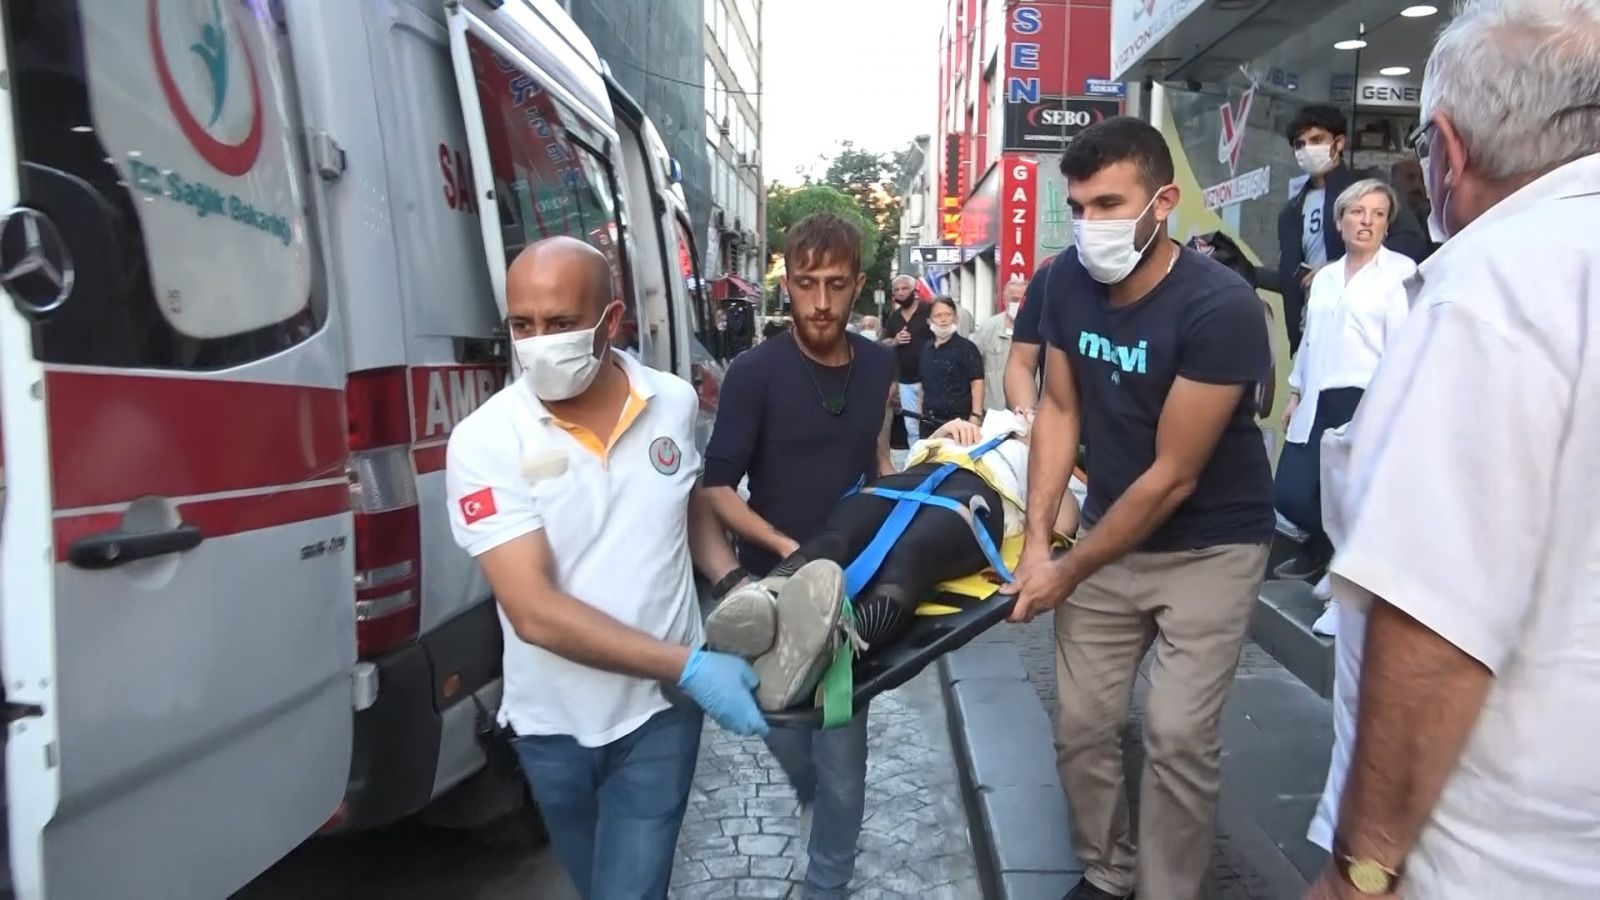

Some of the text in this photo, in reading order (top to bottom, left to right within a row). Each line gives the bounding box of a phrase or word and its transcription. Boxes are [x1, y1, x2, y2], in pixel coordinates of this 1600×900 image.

[1362, 84, 1421, 101] GENE
[1041, 109, 1091, 127] SEBO
[438, 142, 480, 215] SA
